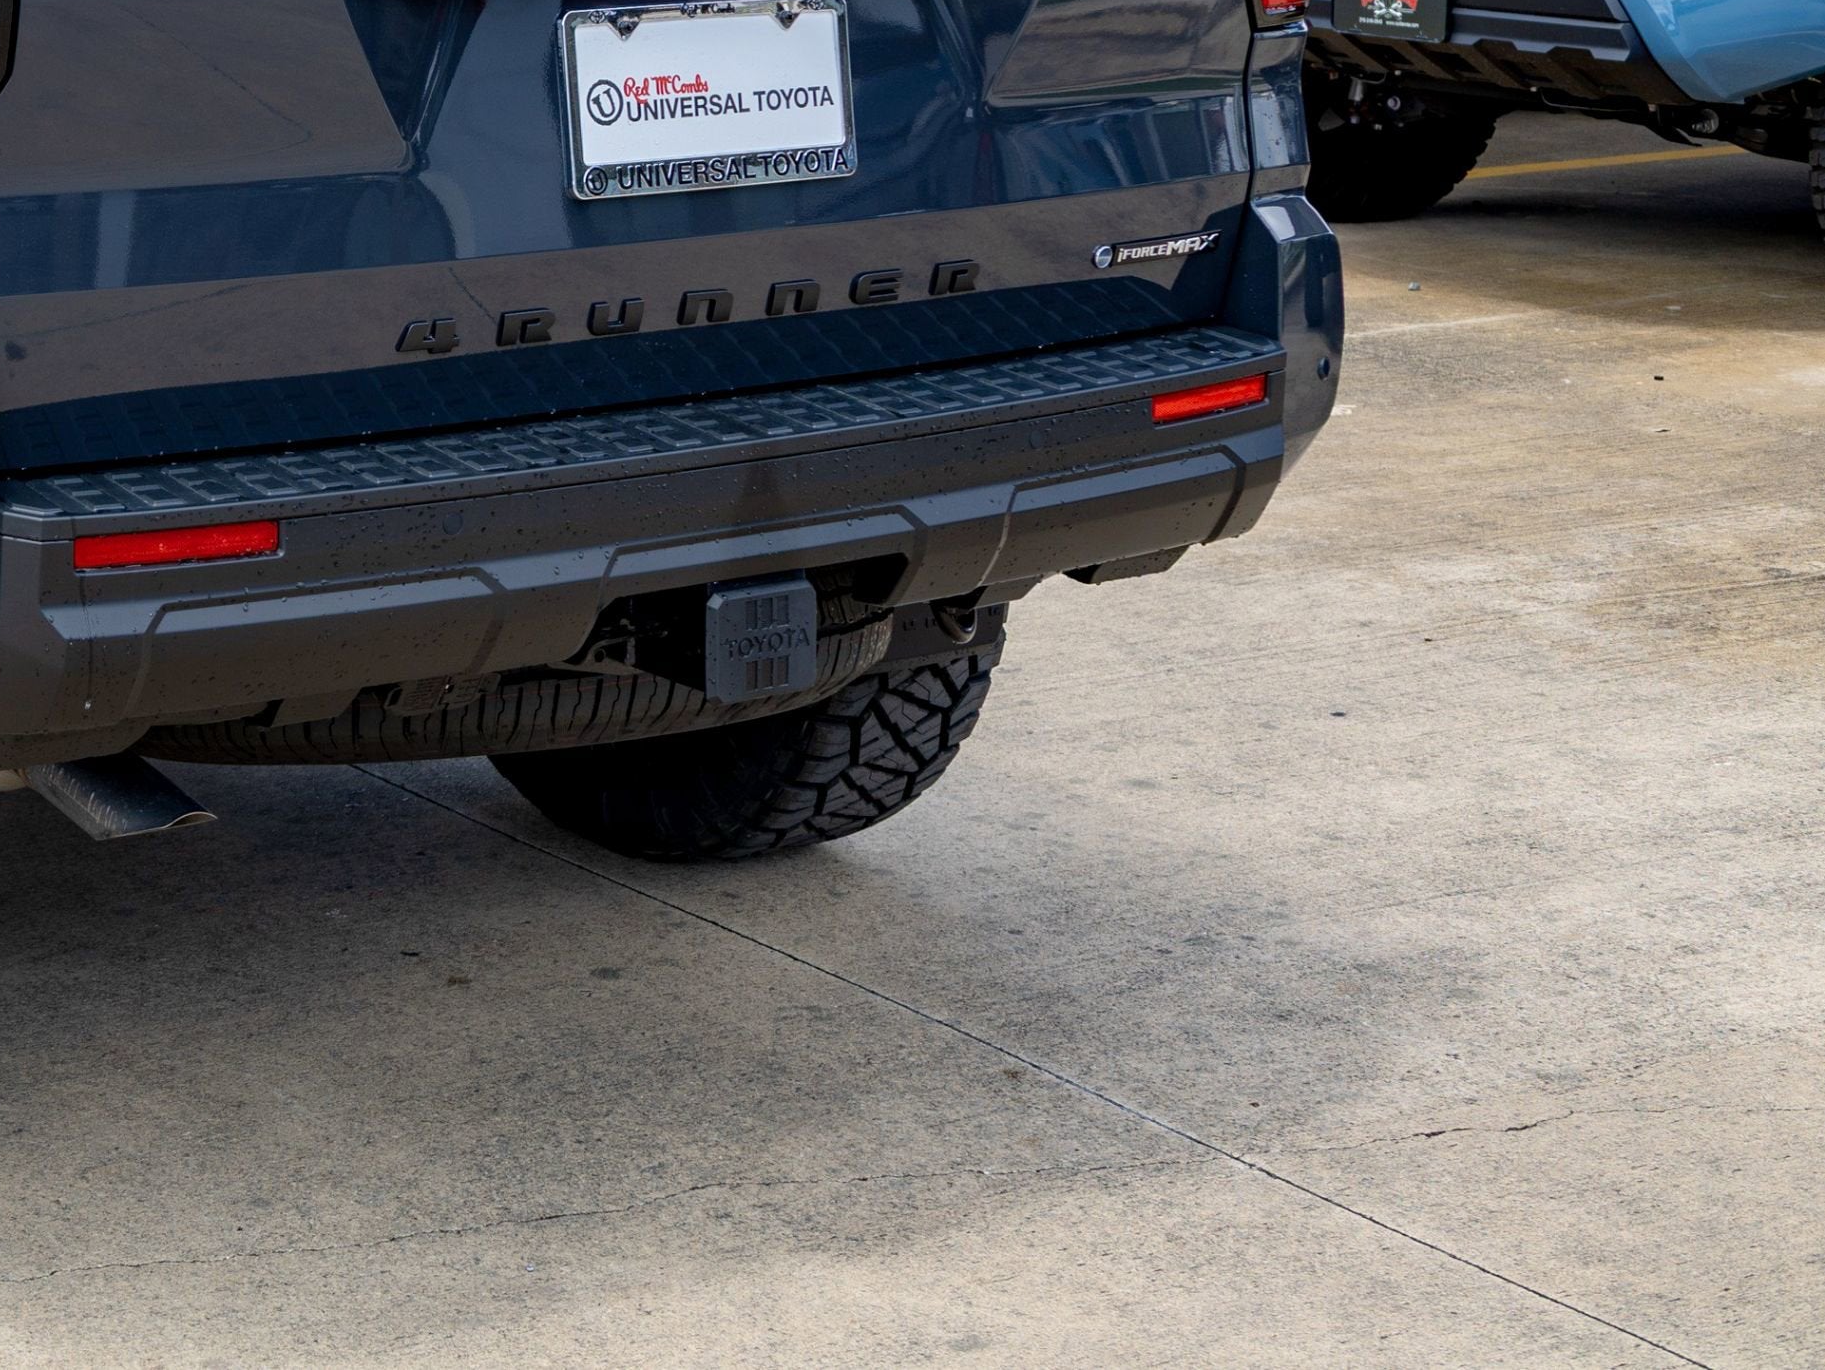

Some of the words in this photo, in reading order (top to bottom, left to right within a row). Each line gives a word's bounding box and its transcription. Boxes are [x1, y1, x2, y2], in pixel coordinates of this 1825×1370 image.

[623, 76, 651, 105] Red
[651, 73, 709, 96] McCombs
[626, 92, 751, 123] UNIVERSAL
[753, 85, 835, 112] TOYOTA
[616, 156, 757, 191] UNIVERSAL
[756, 147, 849, 179] TOYOTA
[394, 258, 982, 355] 4RUNNER
[720, 627, 811, 661] TOYOTA
